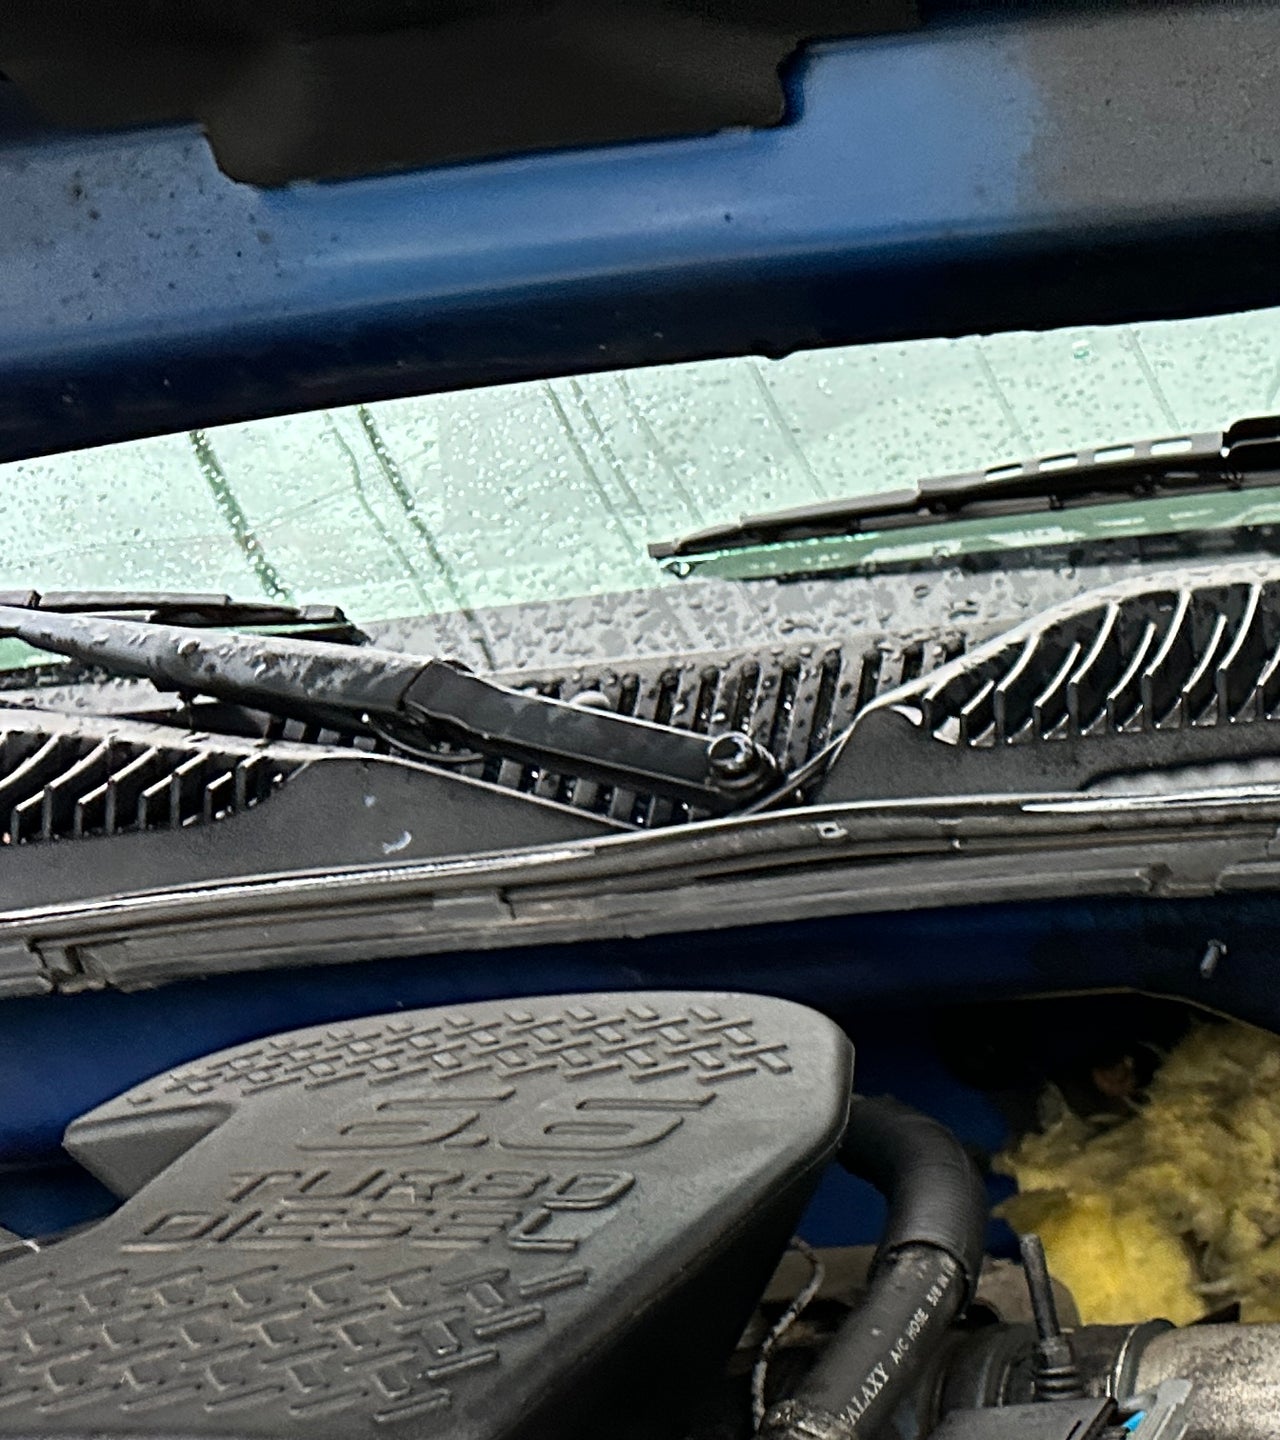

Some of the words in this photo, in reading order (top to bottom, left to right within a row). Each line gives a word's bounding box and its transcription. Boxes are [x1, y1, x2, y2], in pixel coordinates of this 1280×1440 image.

[299, 1085, 717, 1161] 6.6
[228, 1169, 637, 1210] TURBO
[120, 1206, 581, 1253] DIESEL
[840, 1361, 890, 1427] ALAXY
[905, 1306, 930, 1342] HOSE
